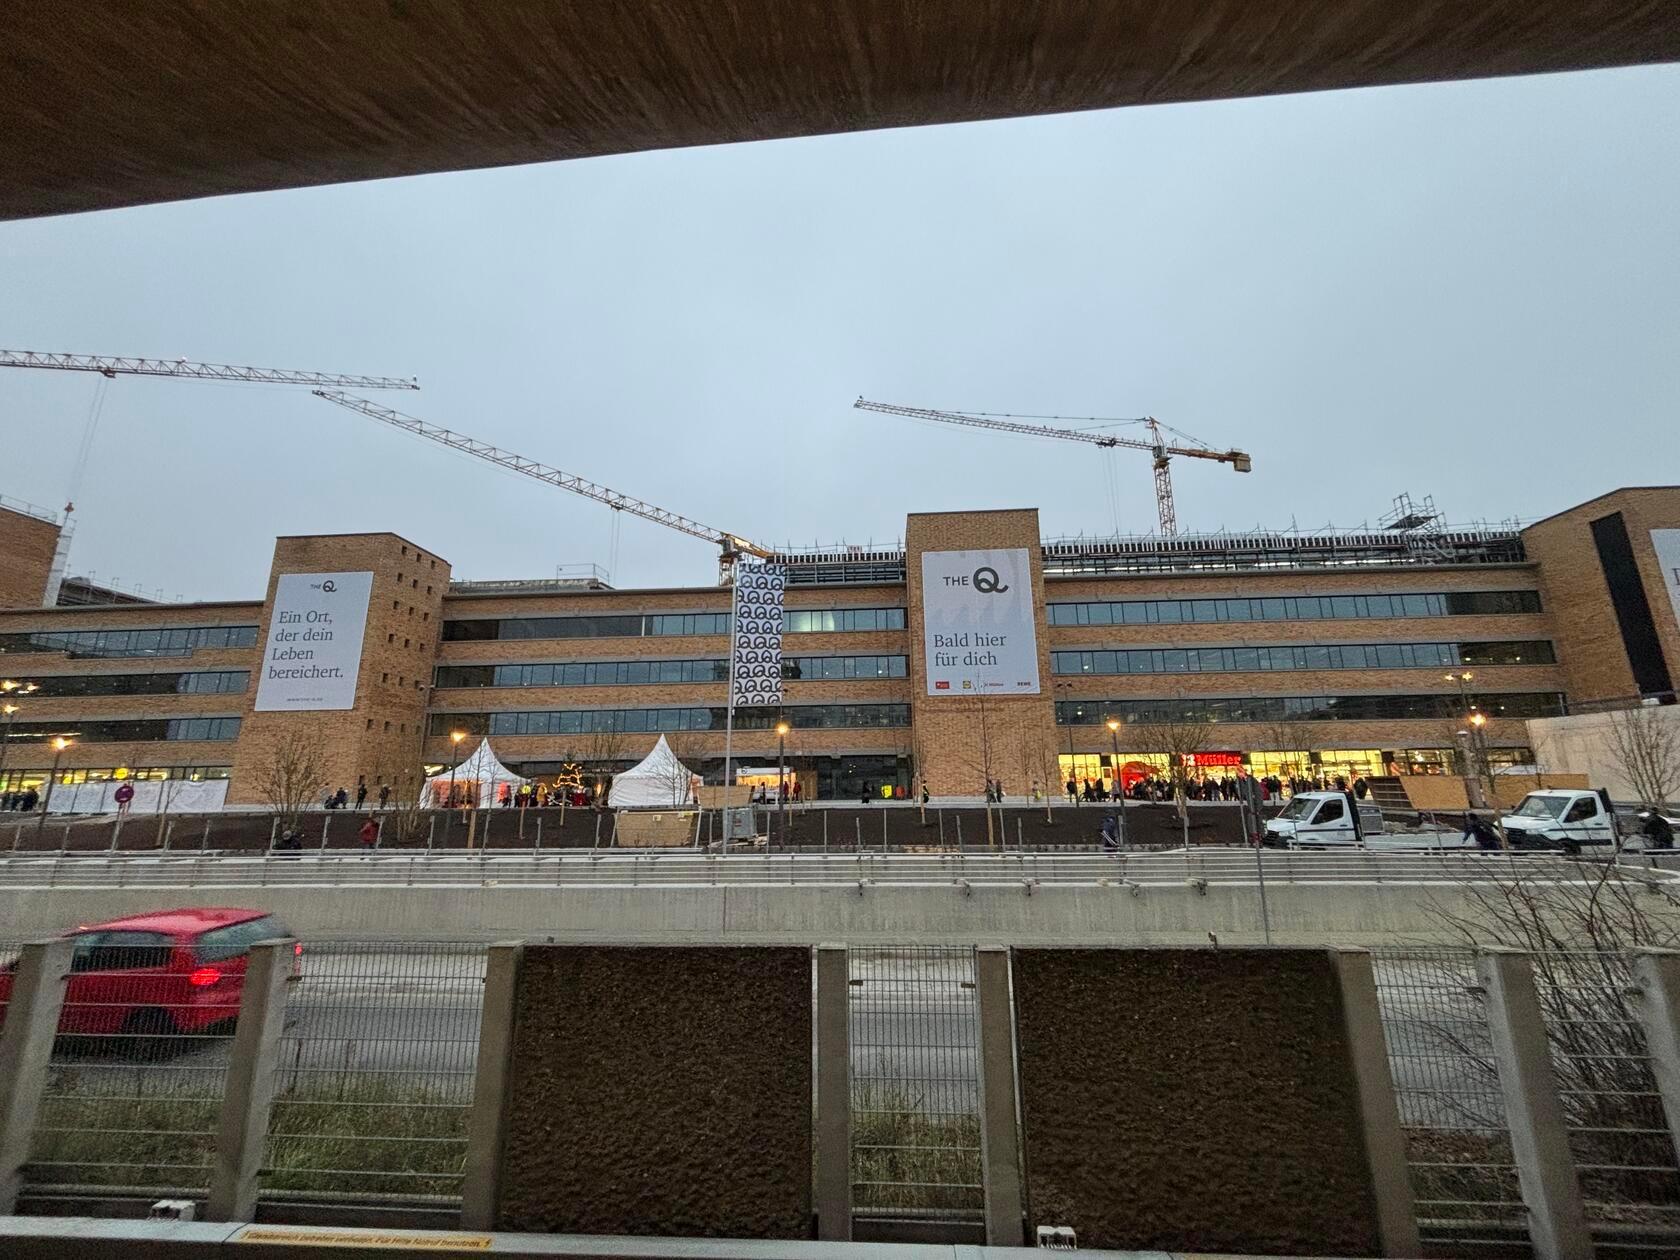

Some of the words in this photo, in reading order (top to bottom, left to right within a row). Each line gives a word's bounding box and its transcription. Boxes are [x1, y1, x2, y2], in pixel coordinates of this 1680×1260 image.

[322, 580, 338, 593] Q
[942, 576, 970, 587] THE
[973, 566, 1009, 593] Q
[278, 611, 301, 624] Ein
[306, 610, 333, 625] Ort,
[275, 628, 300, 642] der
[302, 628, 333, 641] dein
[934, 632, 969, 648] Bald
[975, 632, 1007, 647] hier
[272, 647, 314, 661] Leben
[935, 652, 958, 667] für
[963, 651, 998, 666] dich
[268, 665, 344, 680] bereichert.
[1195, 754, 1241, 766] Müller
